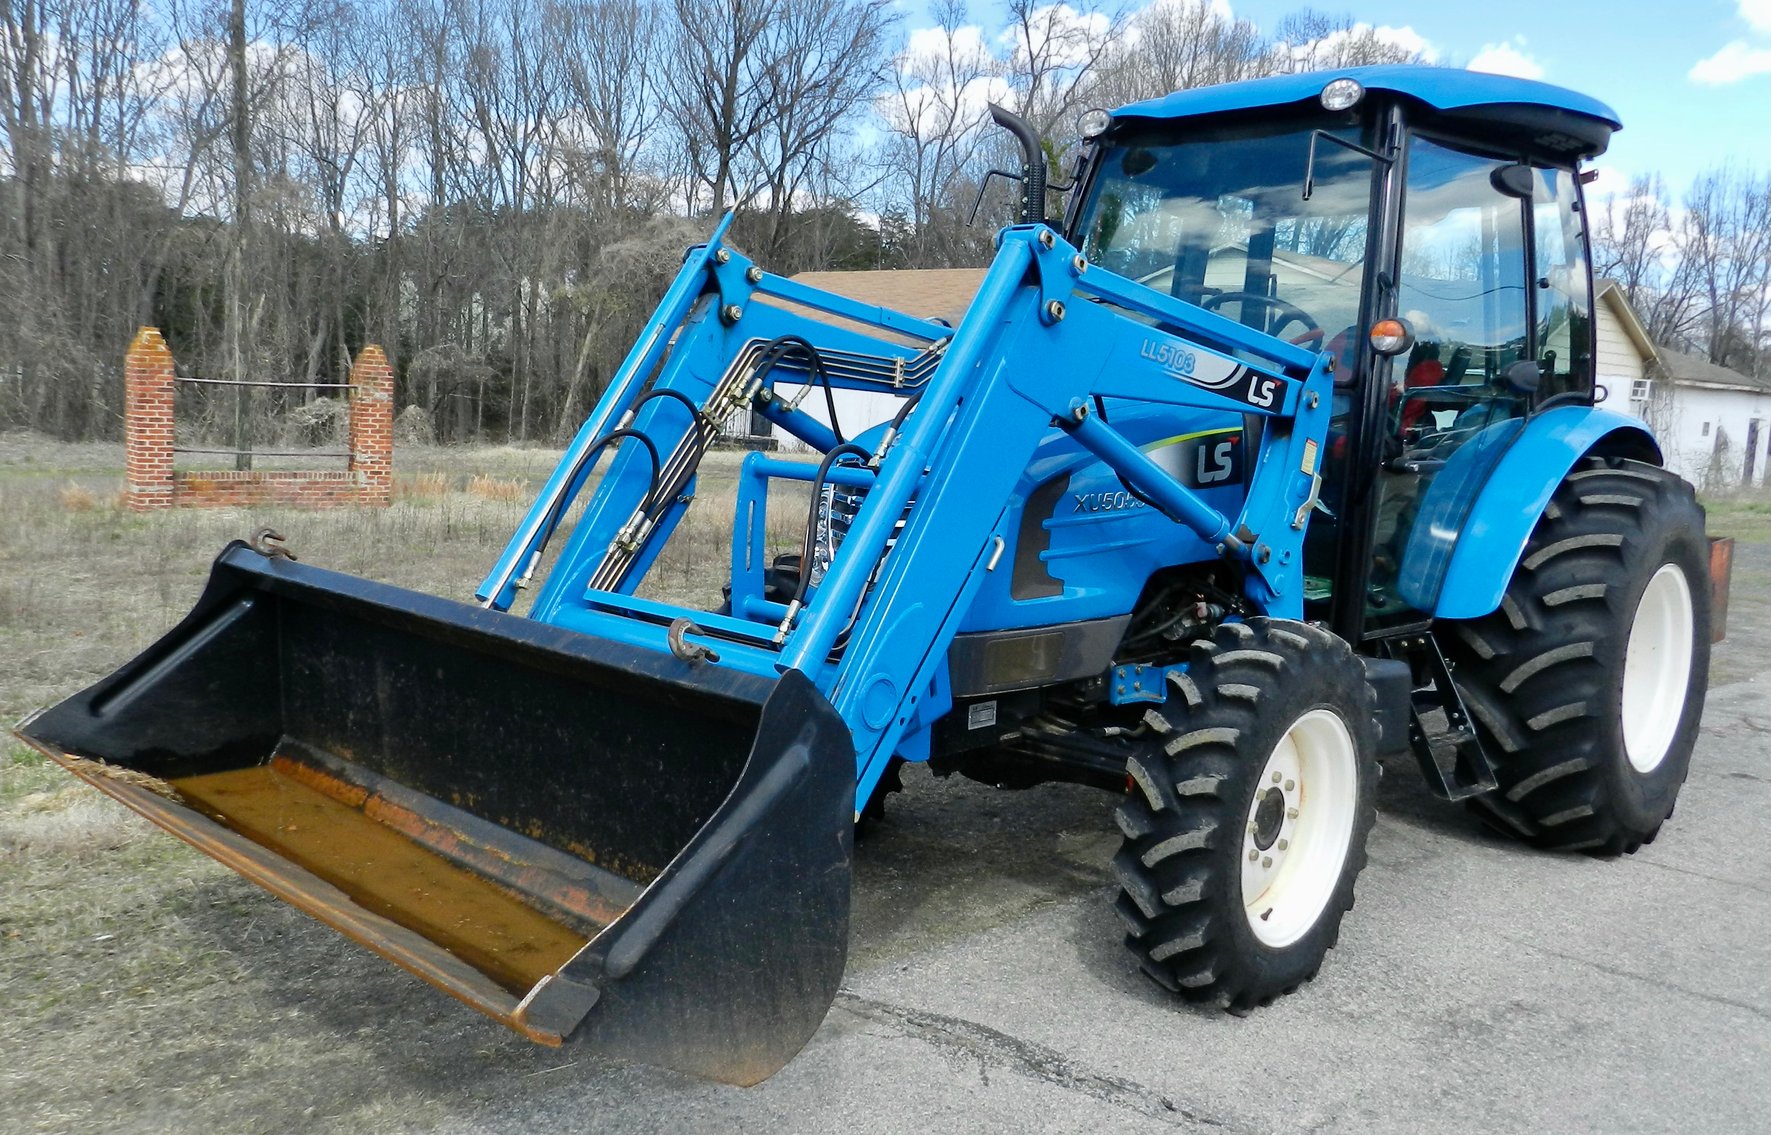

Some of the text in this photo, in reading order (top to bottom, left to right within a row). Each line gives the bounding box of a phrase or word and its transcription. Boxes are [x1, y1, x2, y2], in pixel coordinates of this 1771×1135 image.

[1140, 338, 1196, 374] LL5103
[1247, 375, 1276, 407] LS
[1197, 442, 1232, 483] LS
